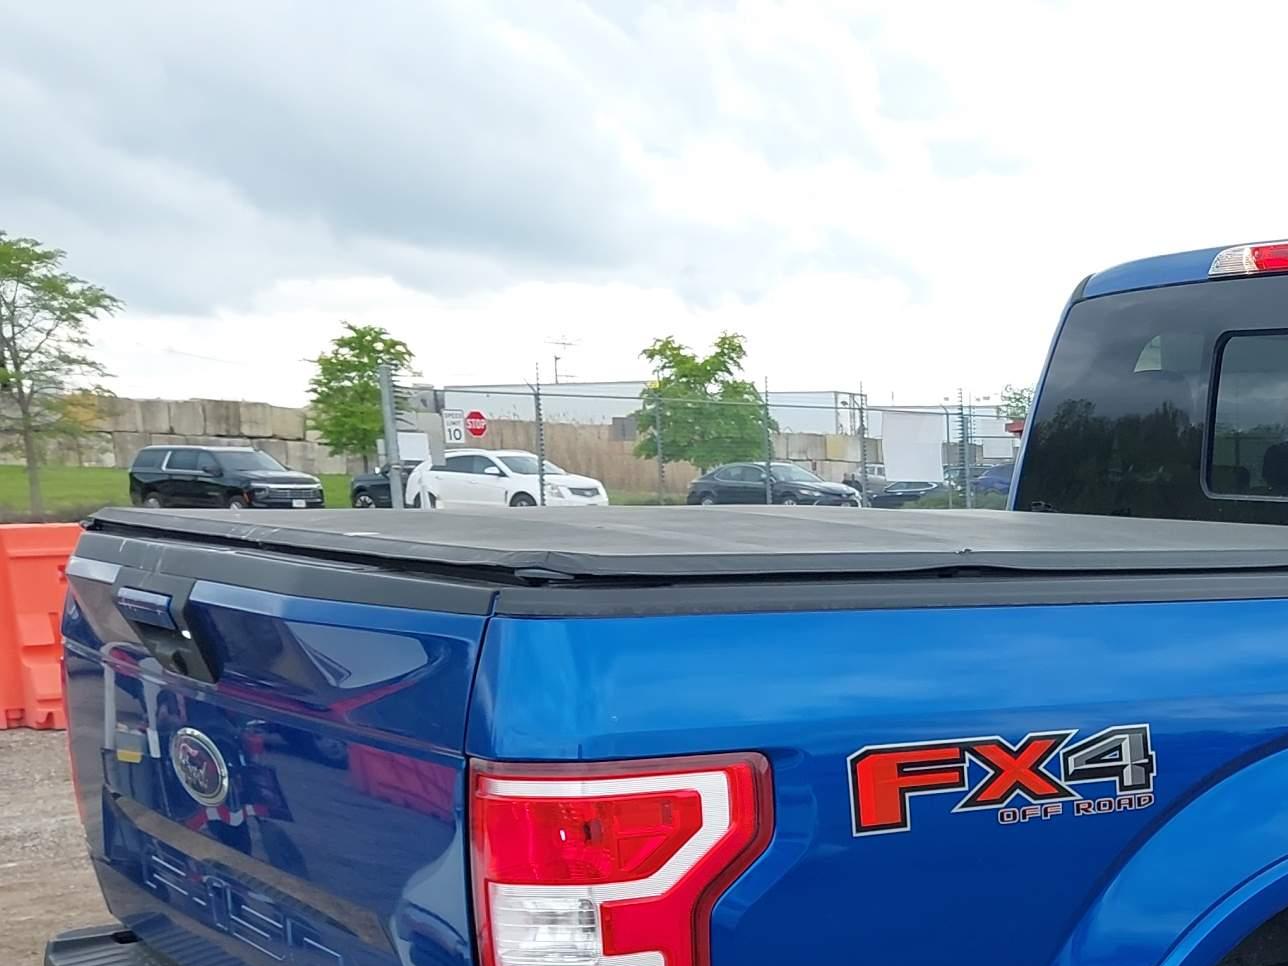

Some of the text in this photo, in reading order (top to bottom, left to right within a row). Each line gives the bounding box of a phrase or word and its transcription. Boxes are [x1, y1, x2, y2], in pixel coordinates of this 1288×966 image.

[448, 428, 462, 441] 10
[466, 418, 487, 429] STOP
[847, 723, 1157, 837] FX4
[998, 792, 1156, 825] OFF ROAD
